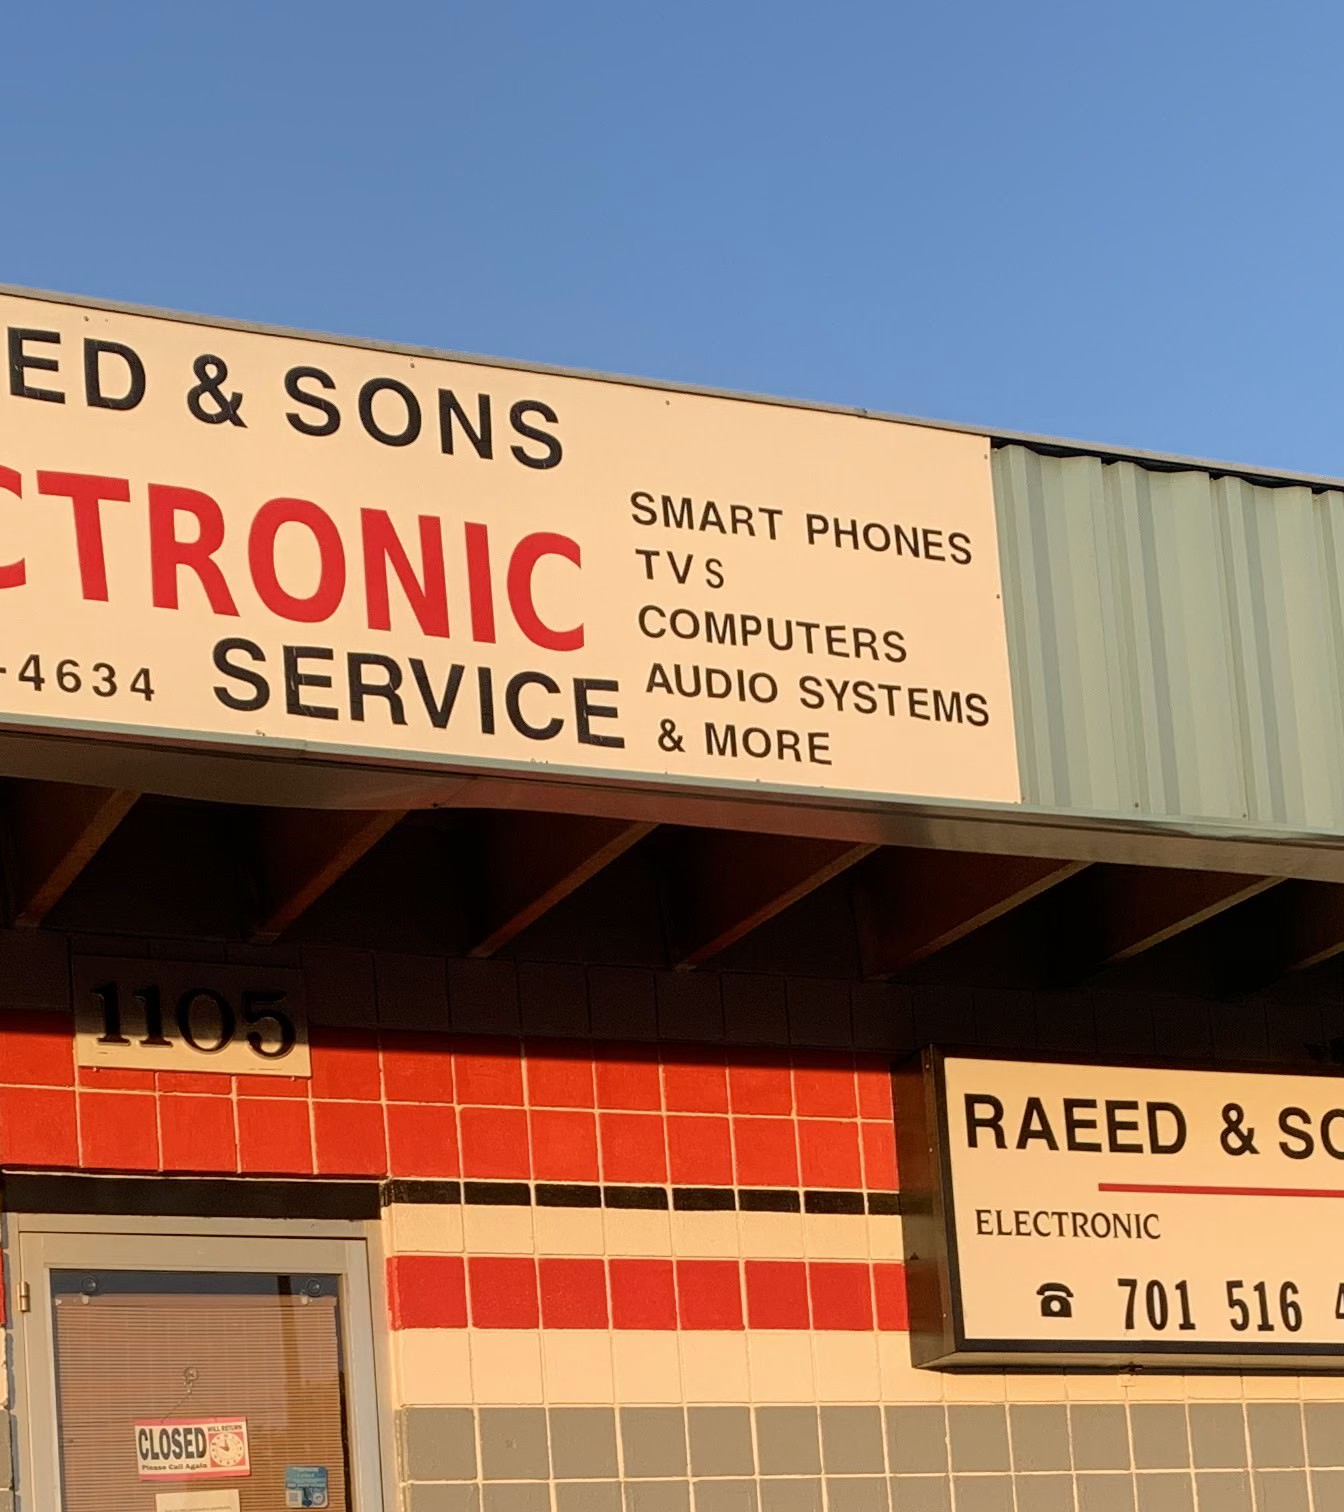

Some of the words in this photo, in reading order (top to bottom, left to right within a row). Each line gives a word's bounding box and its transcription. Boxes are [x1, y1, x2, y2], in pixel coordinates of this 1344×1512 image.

[186, 353, 248, 429] &
[283, 365, 564, 470] SONS
[629, 491, 783, 542] SMART
[805, 513, 973, 566] PHONES
[637, 605, 907, 664] COMPUTERS
[212, 637, 626, 749] SERVICE
[645, 662, 779, 705] AUDIO
[799, 675, 990, 728] SYSTEMS
[657, 719, 685, 753] &
[704, 724, 833, 766] MORE
[91, 982, 297, 1060] 1105
[963, 1092, 1188, 1155] RAEED
[1219, 1102, 1260, 1157] &
[975, 1208, 1162, 1240] ELECTRONIC
[1117, 1278, 1197, 1331] 701
[1225, 1280, 1303, 1333] 516
[138, 1427, 208, 1461] CLOSED
